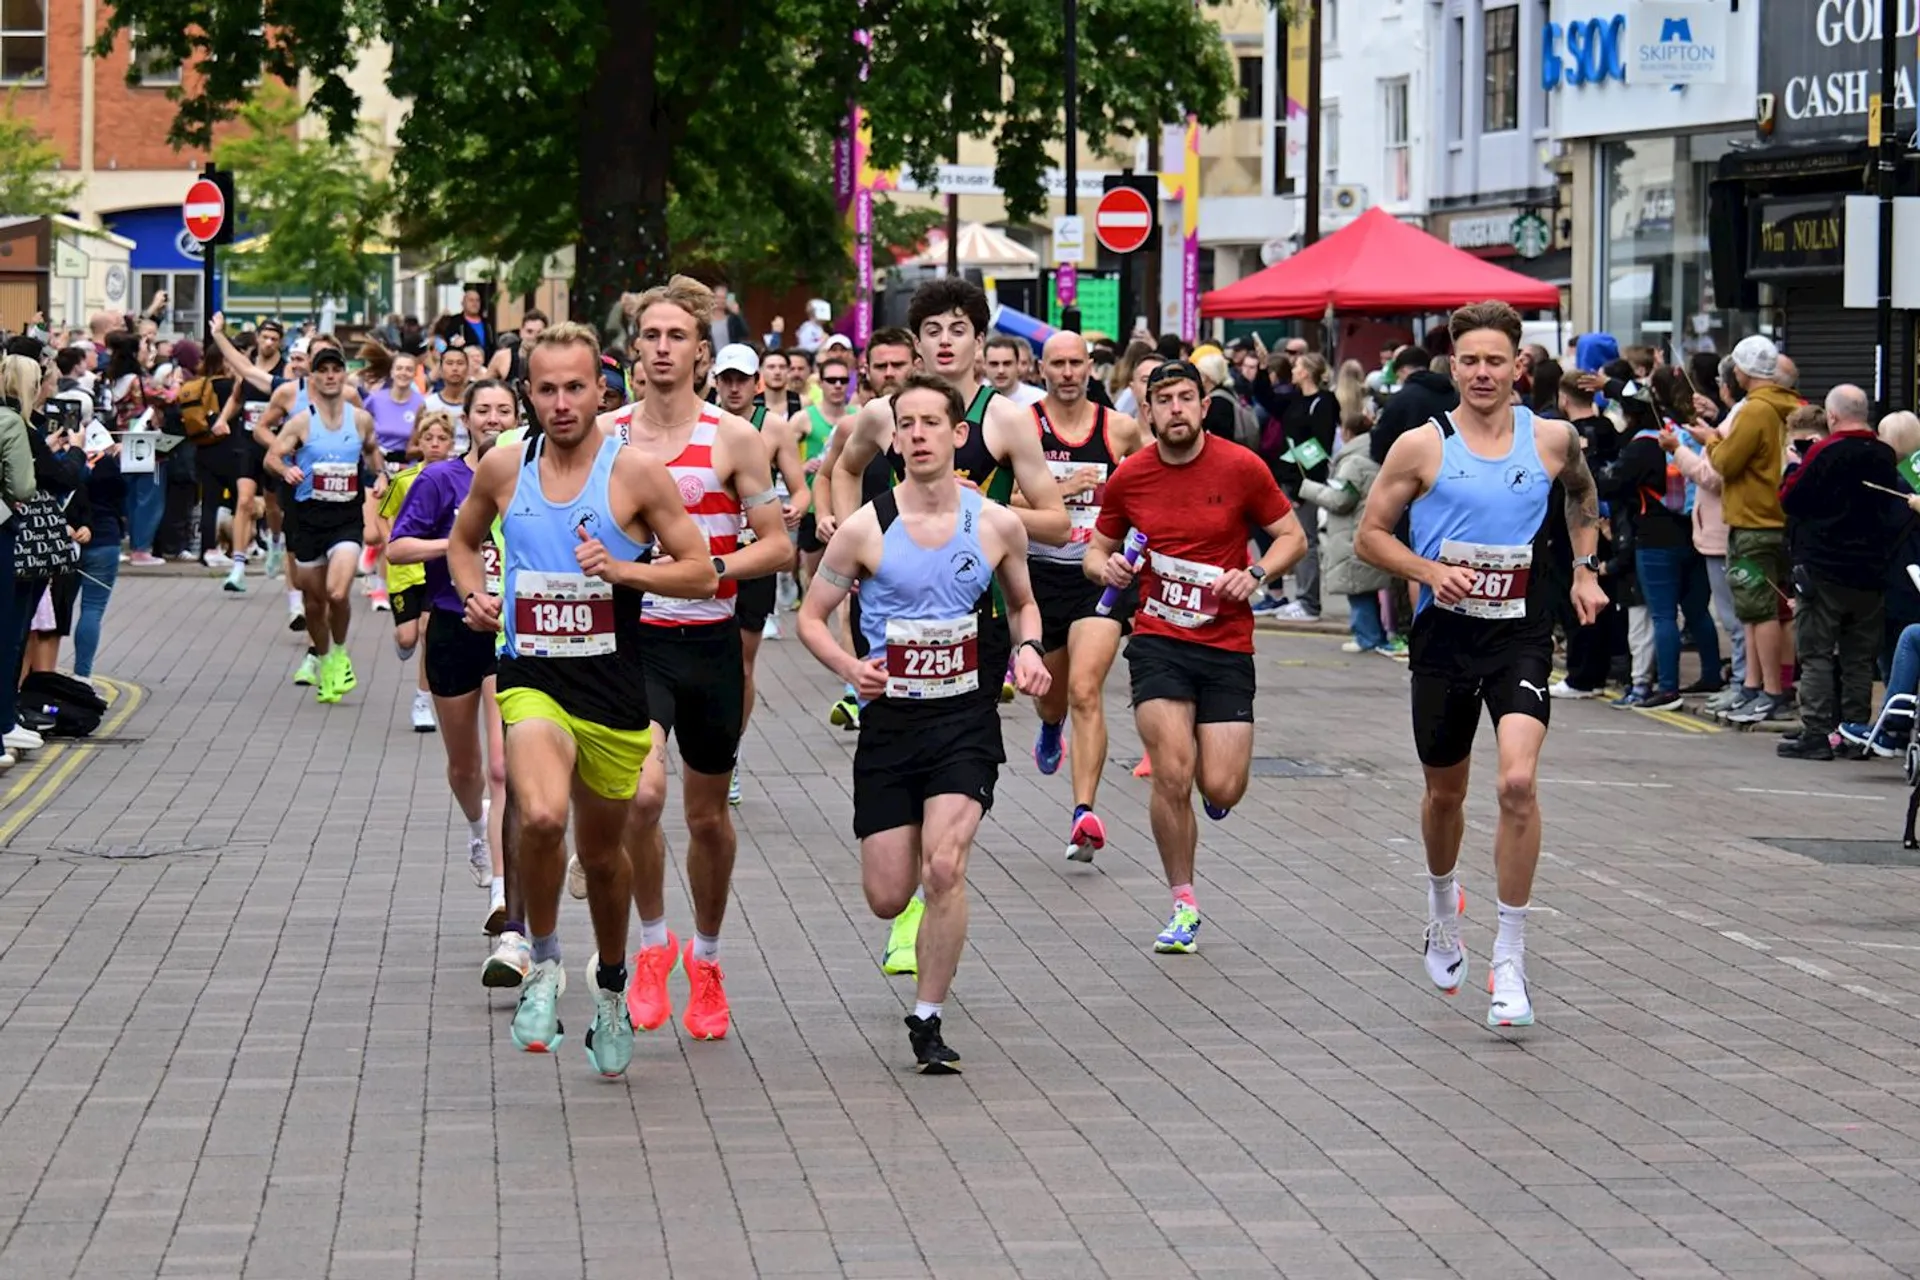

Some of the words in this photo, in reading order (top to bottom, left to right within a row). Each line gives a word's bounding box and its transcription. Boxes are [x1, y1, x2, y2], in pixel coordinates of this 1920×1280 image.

[1639, 44, 1716, 62] SKIPTON
[1784, 70, 1869, 120] CASH
[1792, 217, 1840, 250] NOLAN
[22, 529, 46, 541] Dior
[27, 554, 48, 568] Dior
[1161, 580, 1202, 611] 19-A
[1470, 571, 1514, 598] 267
[531, 603, 593, 633] 1349
[904, 645, 965, 677] 2254
